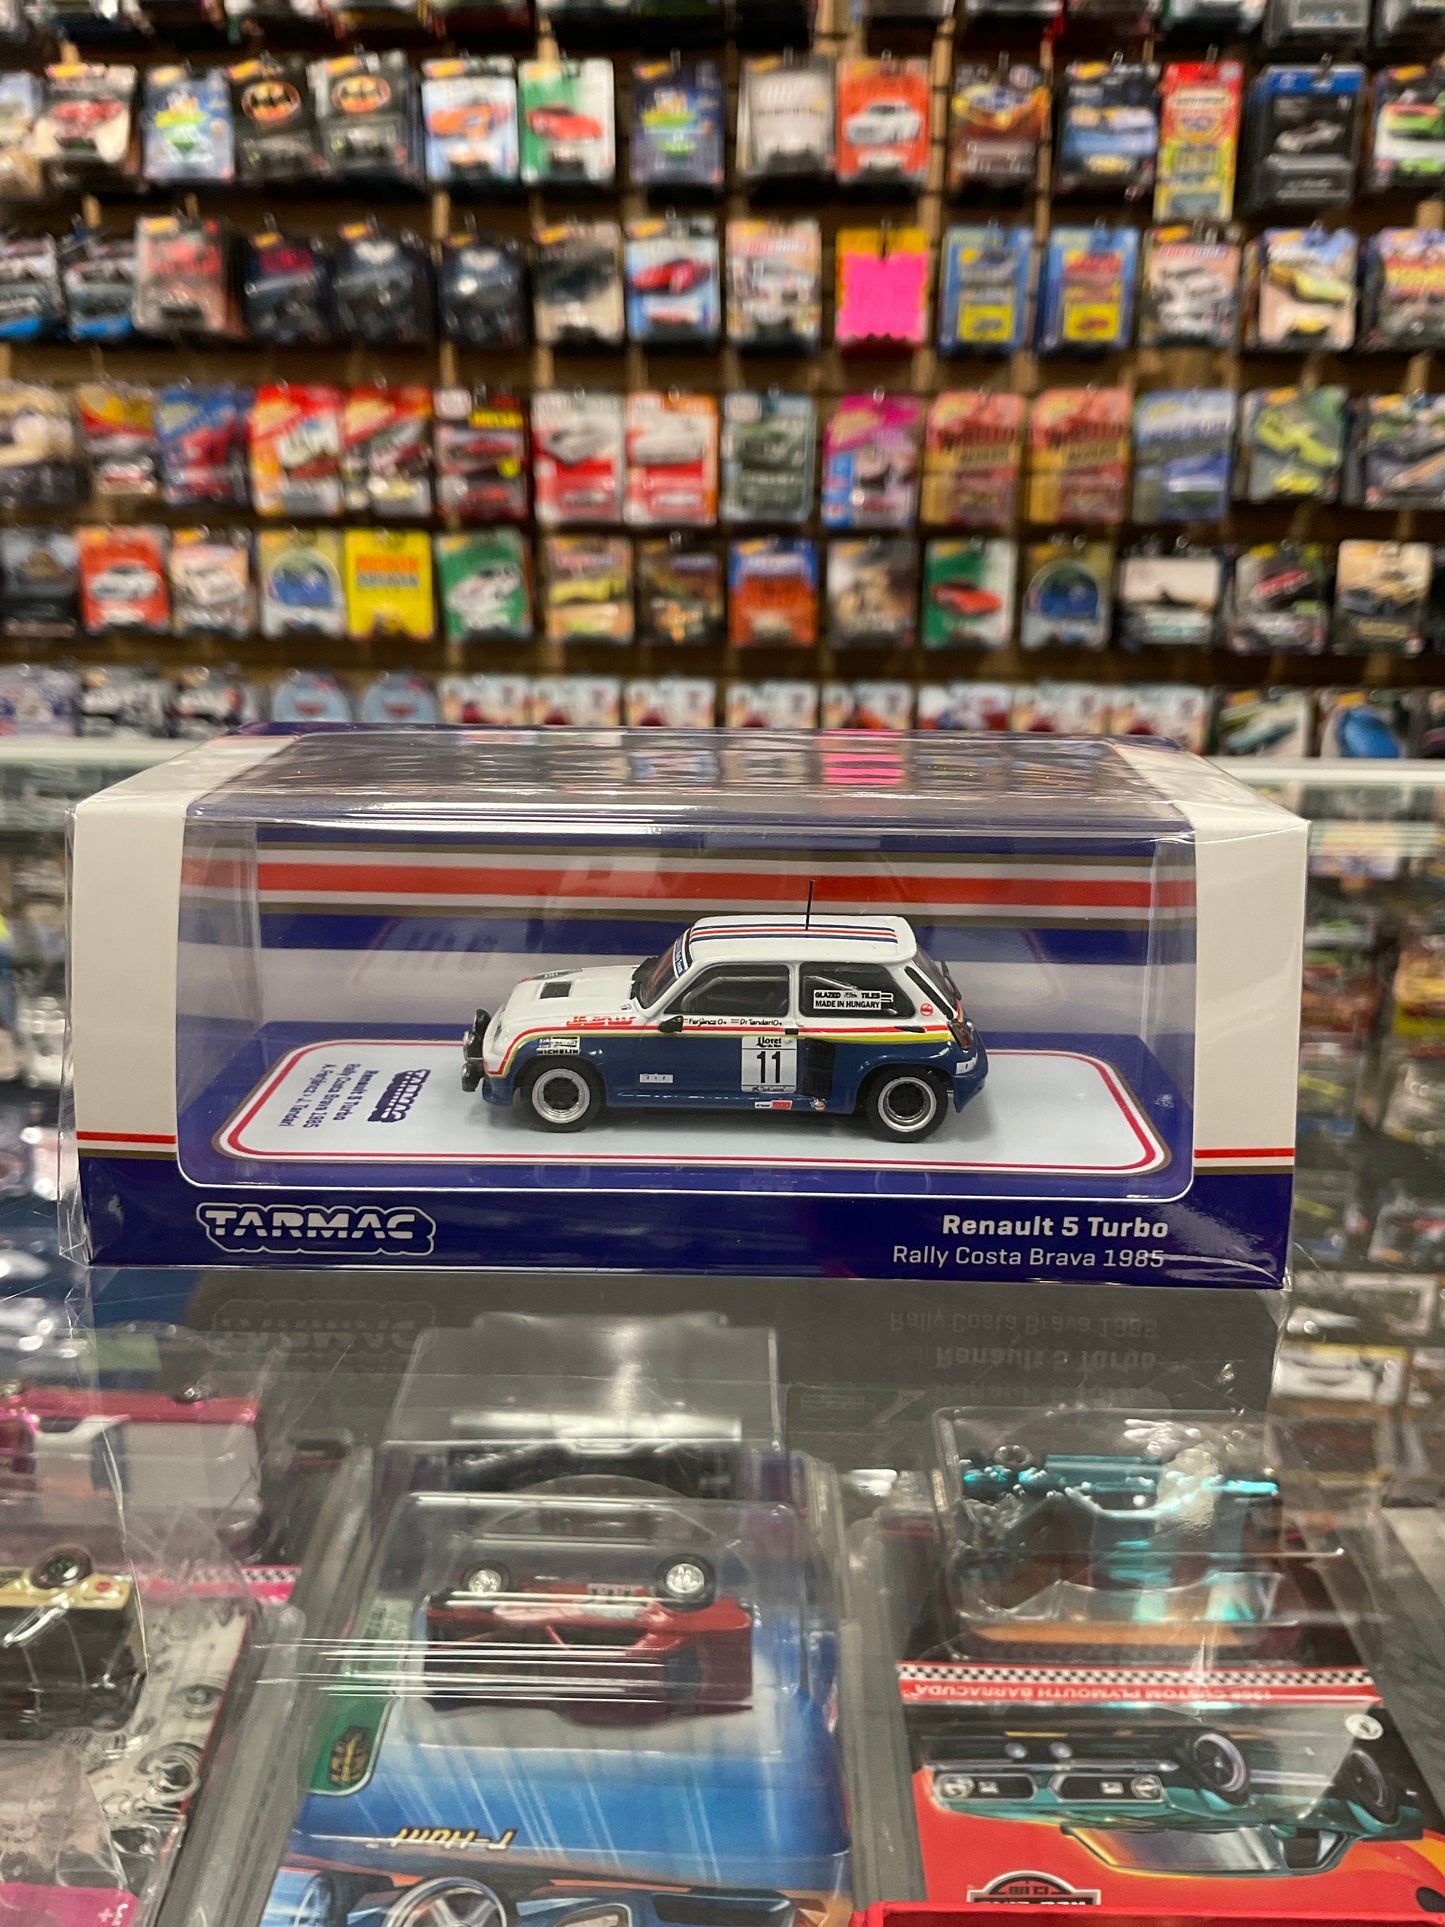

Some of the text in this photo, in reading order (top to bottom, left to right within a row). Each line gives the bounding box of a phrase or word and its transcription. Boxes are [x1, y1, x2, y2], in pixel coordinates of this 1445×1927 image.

[815, 1000, 836, 1008] MADE
[846, 1001, 881, 1009] HUNGARY
[757, 1051, 780, 1083] 11
[350, 1070, 379, 1095] Renault
[302, 1063, 361, 1128] Rally Costa Brava 1985
[333, 1101, 359, 1120] Turbo
[205, 1210, 415, 1239] TARMAC
[942, 1214, 1169, 1238] Renault 5 Turbo
[893, 1245, 1165, 1268] Rally Costa Brava 1985
[916, 1684, 1033, 1699] BARRACUDA
[1037, 1688, 1141, 1699] PLYMOUTH
